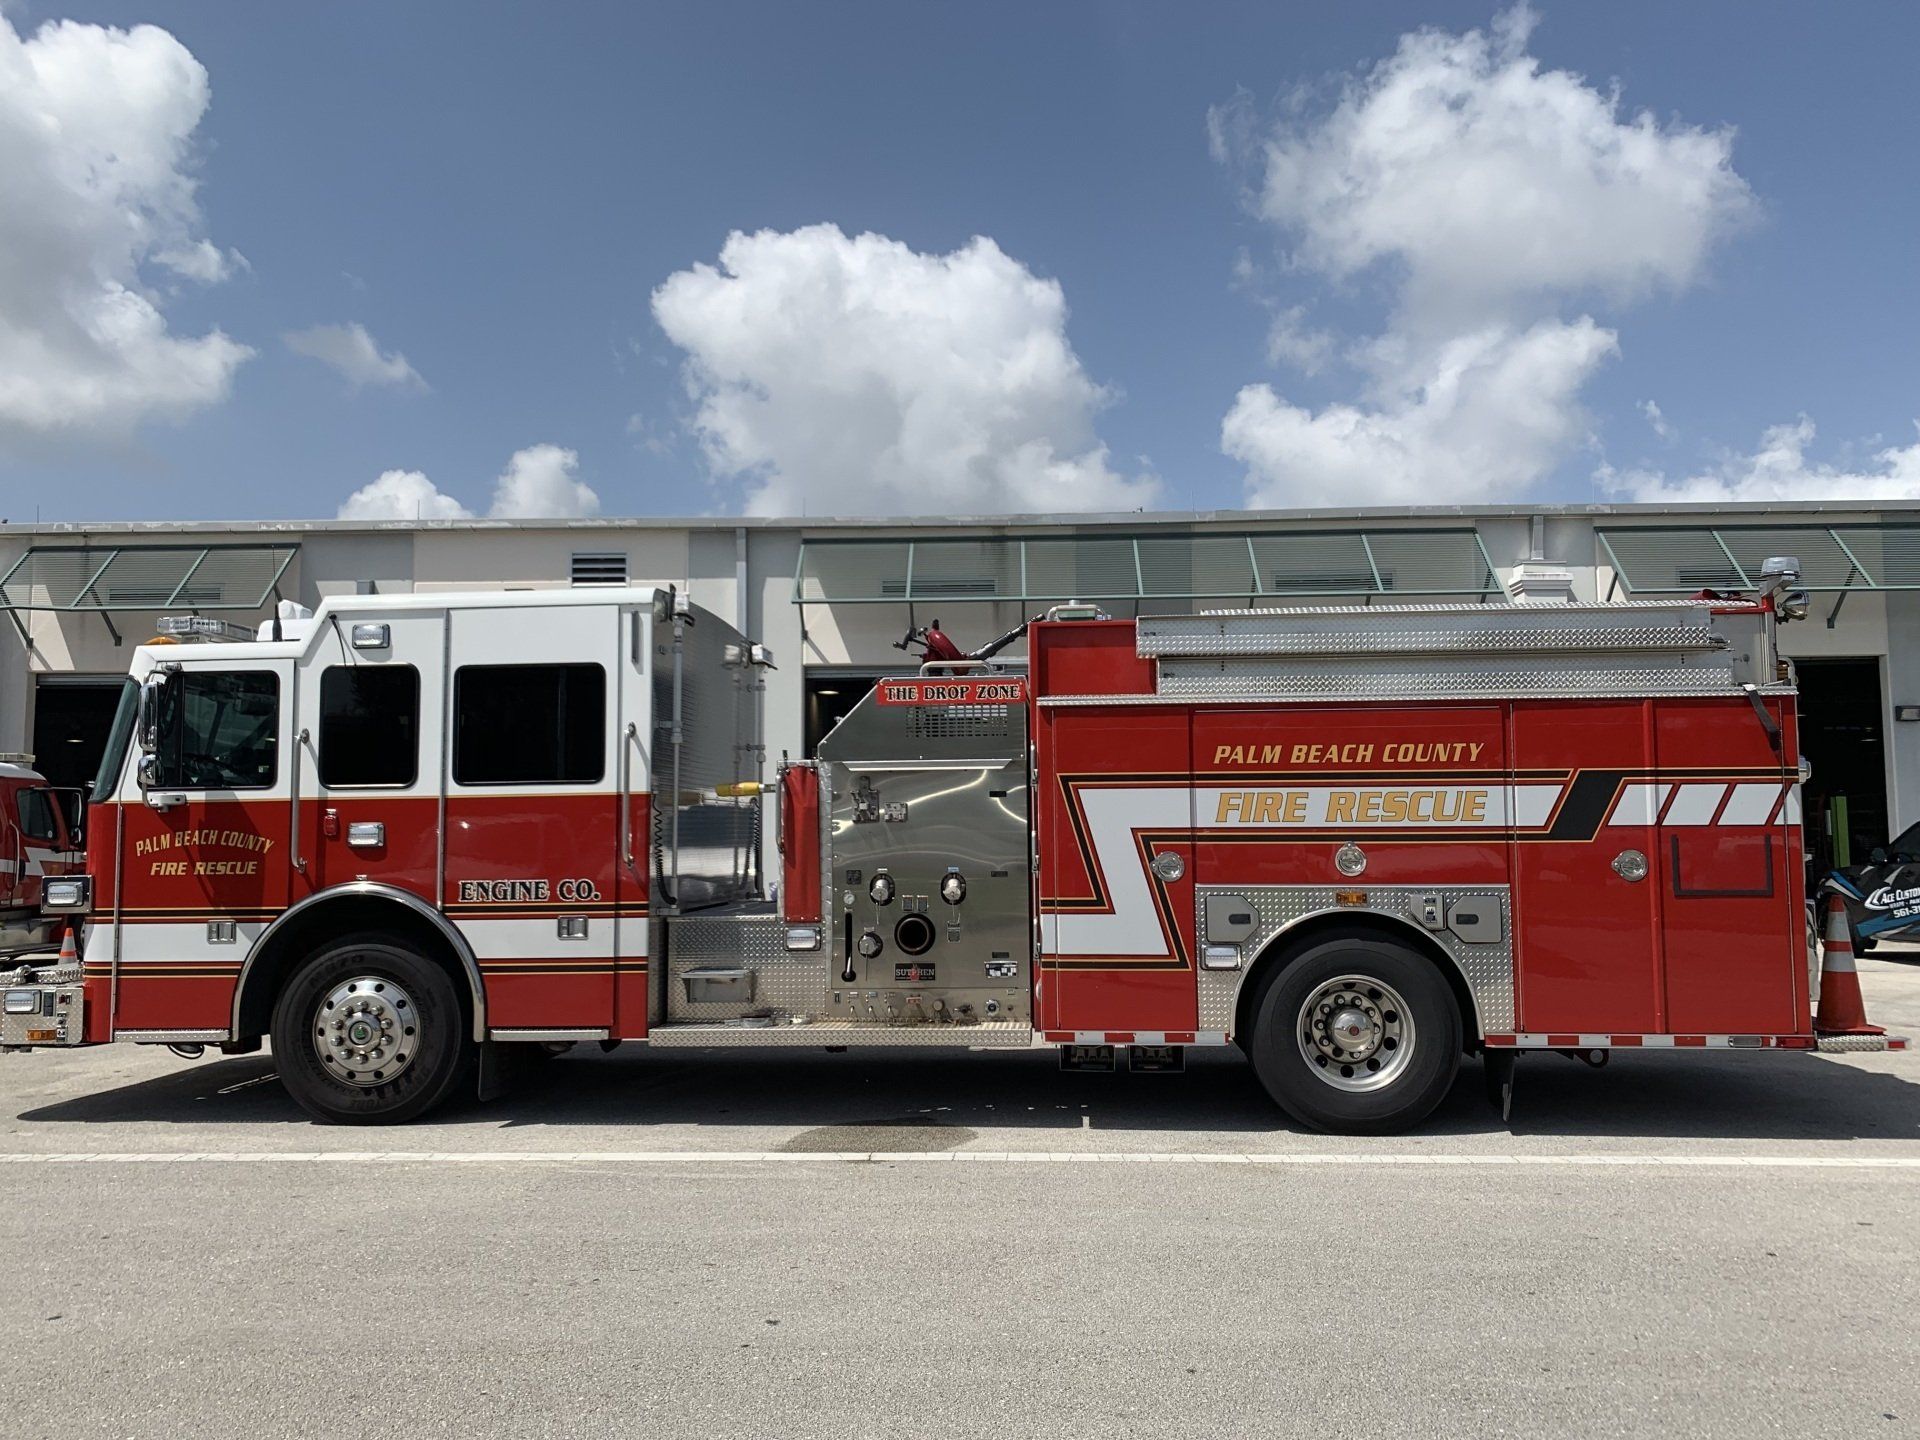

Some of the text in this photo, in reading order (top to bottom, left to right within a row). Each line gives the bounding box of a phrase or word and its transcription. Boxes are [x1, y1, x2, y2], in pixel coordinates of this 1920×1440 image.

[885, 684, 1021, 701] THE DROP ZONE
[1213, 742, 1485, 765] PALM BEACH COUNTY
[1215, 790, 1488, 823] FIRE RESCUE
[136, 829, 275, 857] PALM BEACH COUNTY
[150, 861, 258, 876] FIRE RESCUE
[459, 878, 602, 902] ENGINE CO.
[1880, 893, 1895, 905] ACE
[895, 968, 935, 976] SUTPHEN
